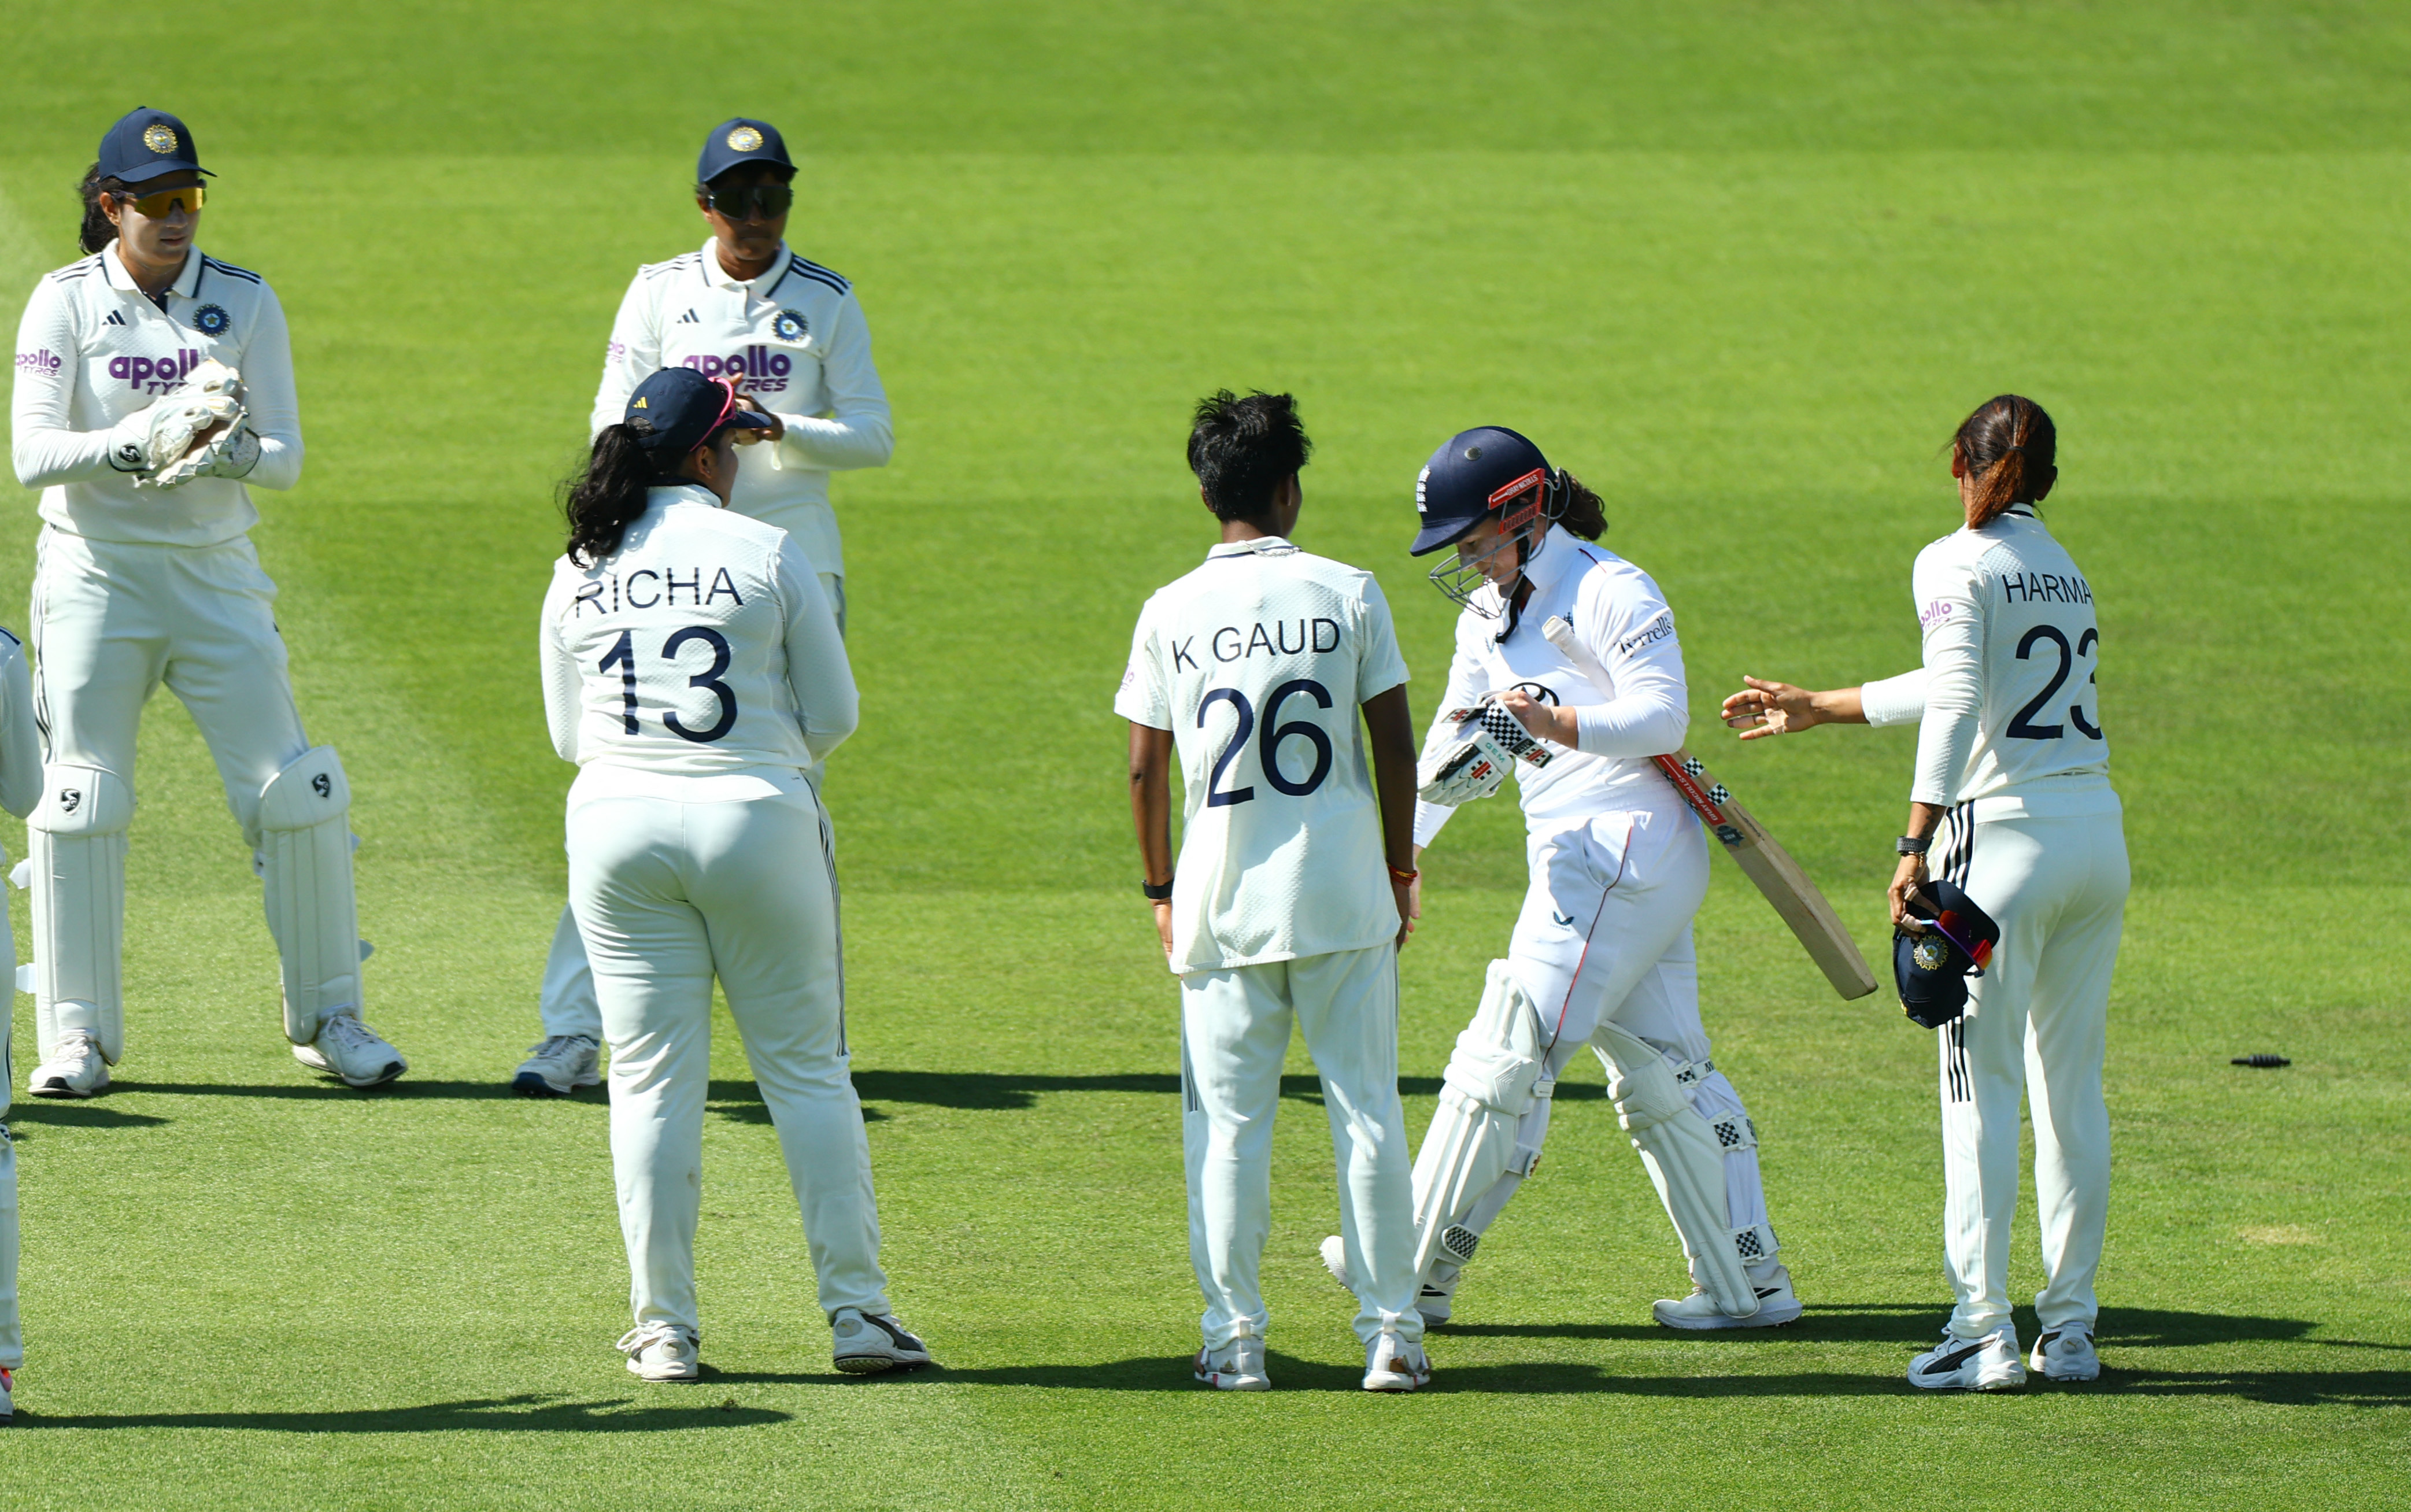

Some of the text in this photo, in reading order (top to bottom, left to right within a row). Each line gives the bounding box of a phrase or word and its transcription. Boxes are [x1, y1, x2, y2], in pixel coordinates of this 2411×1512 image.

[108, 349, 198, 389] apoll
[575, 567, 744, 618] RICHA
[2002, 572, 2095, 607] HARMA
[1172, 618, 1340, 674] K GAUD
[598, 626, 738, 743] 13
[1197, 679, 1333, 808] 26
[1679, 777, 1718, 821] GRAY NICOLLS
